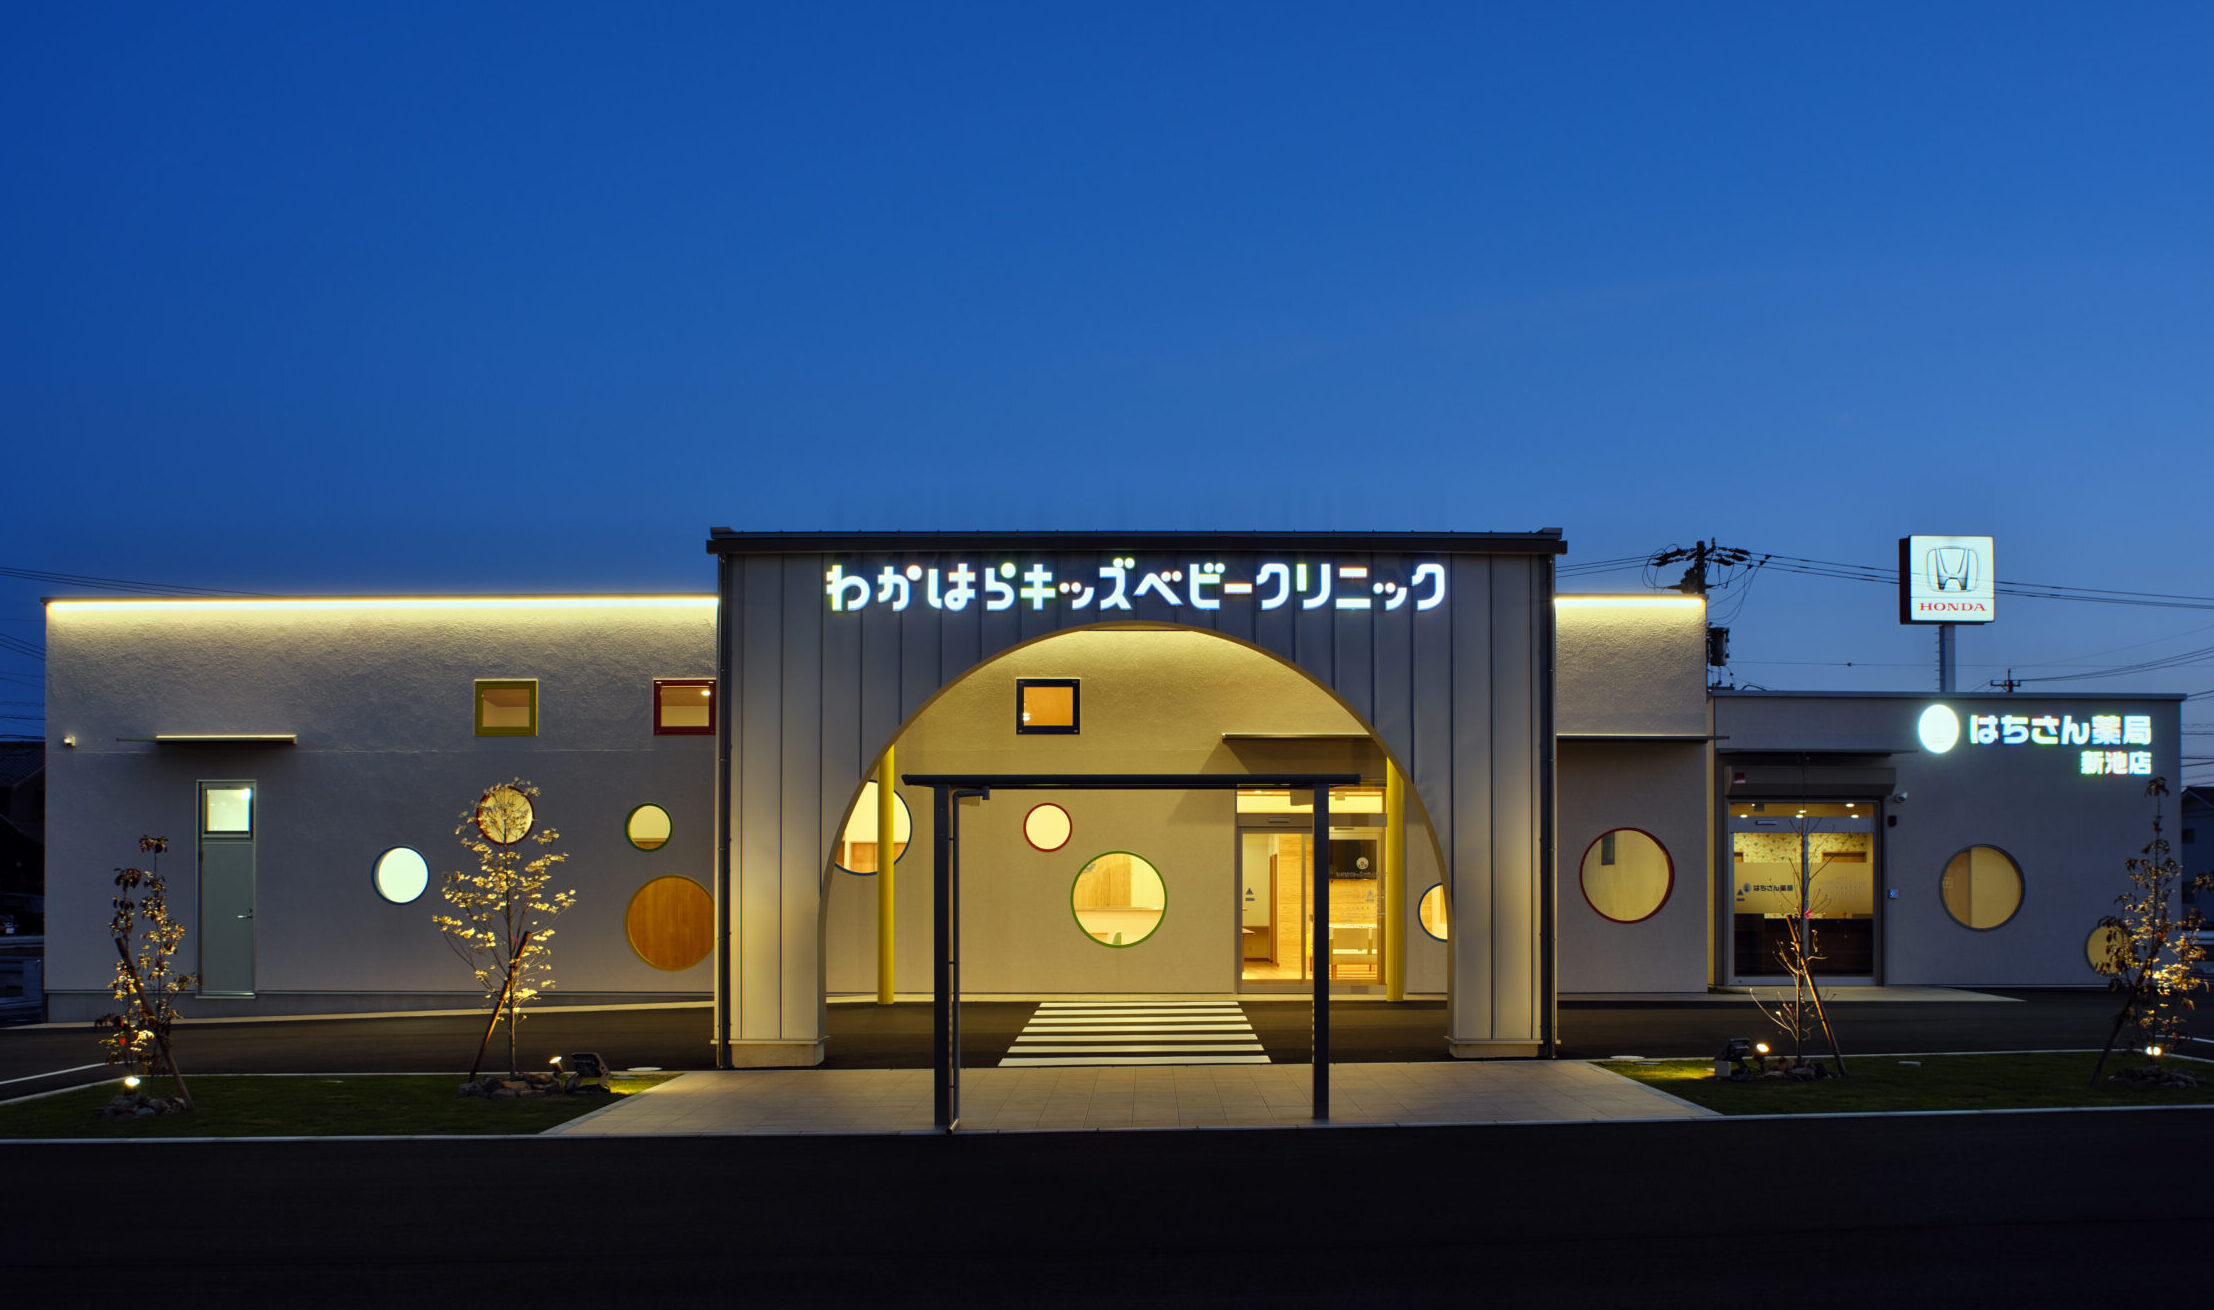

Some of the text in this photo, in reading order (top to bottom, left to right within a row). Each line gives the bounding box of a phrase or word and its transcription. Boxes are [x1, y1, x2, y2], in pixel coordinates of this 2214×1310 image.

[825, 558, 1445, 611] わかはらキッズベビークリニック
[1919, 603, 1986, 612] HONDA
[1969, 714, 2152, 745] はちさん薬局
[2080, 750, 2152, 775] 新池店
